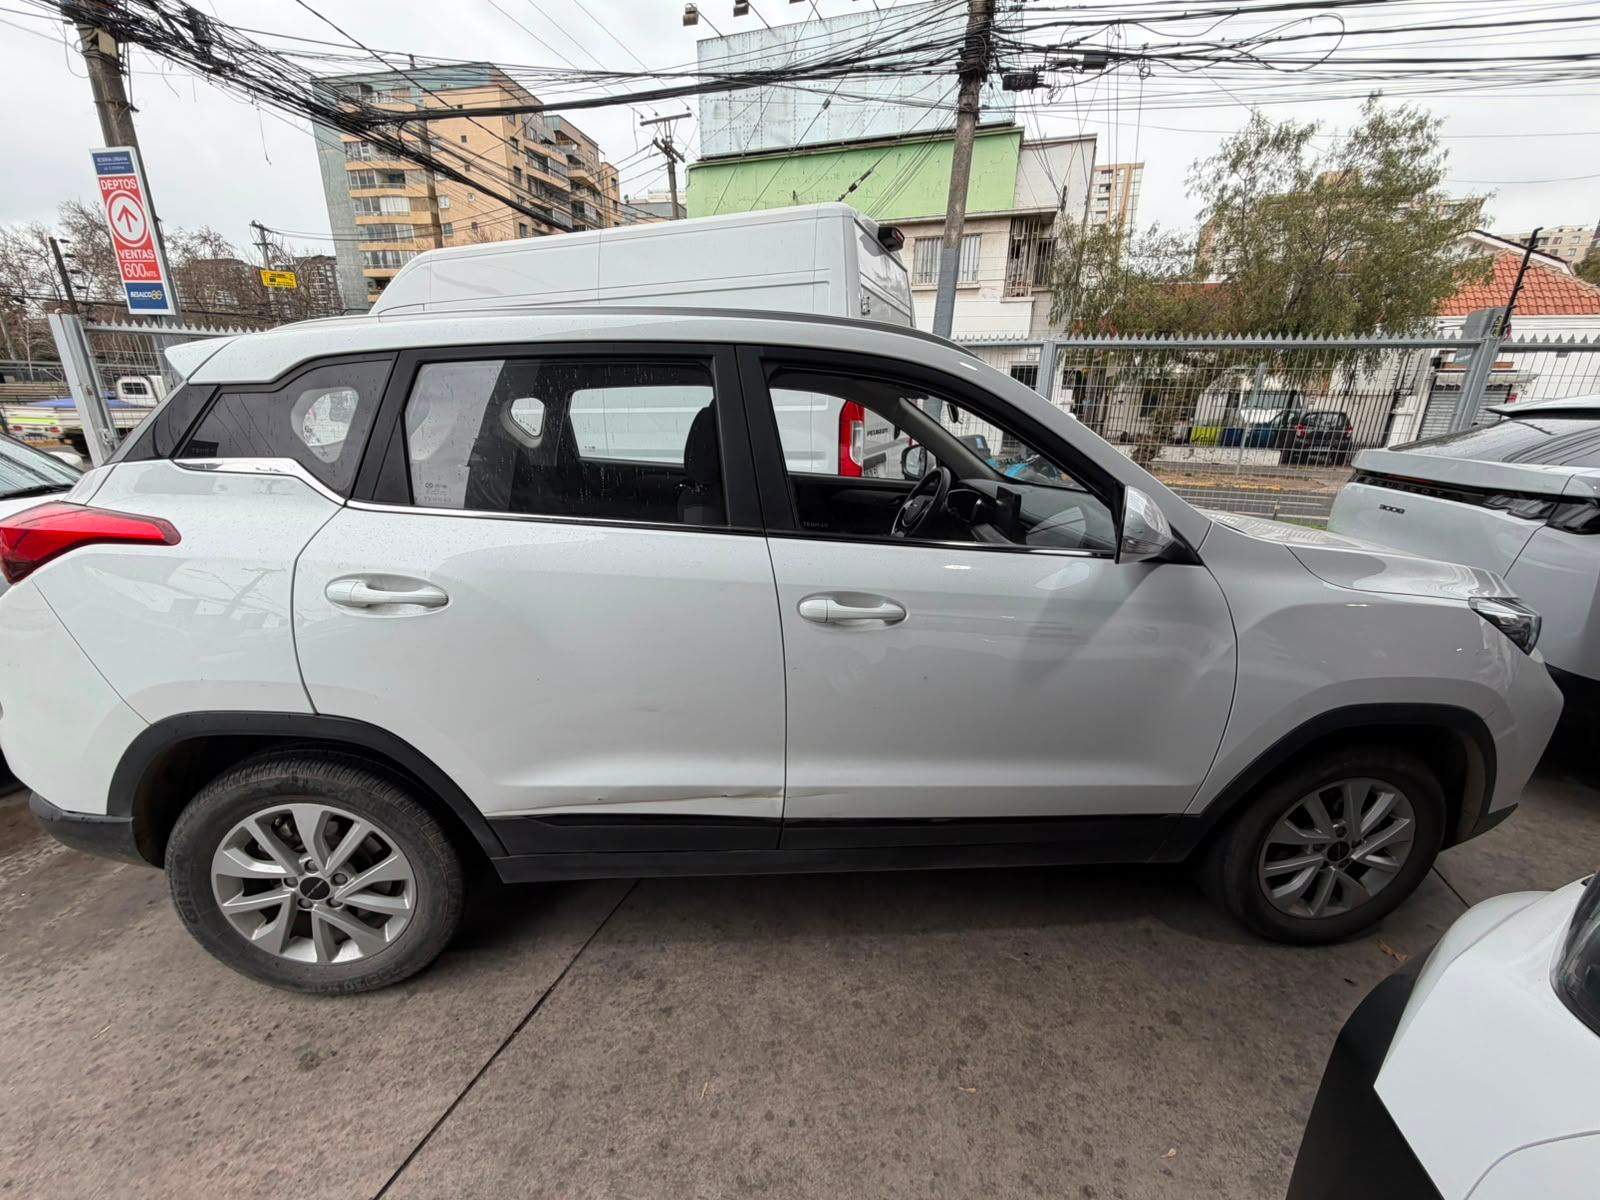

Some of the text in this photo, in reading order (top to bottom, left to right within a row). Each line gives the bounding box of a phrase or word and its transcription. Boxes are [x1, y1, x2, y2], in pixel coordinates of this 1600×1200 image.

[100, 178, 137, 191] DEPTOS
[118, 249, 154, 260] VENTAS
[124, 262, 146, 278] 600
[1379, 503, 1406, 515] 3008
